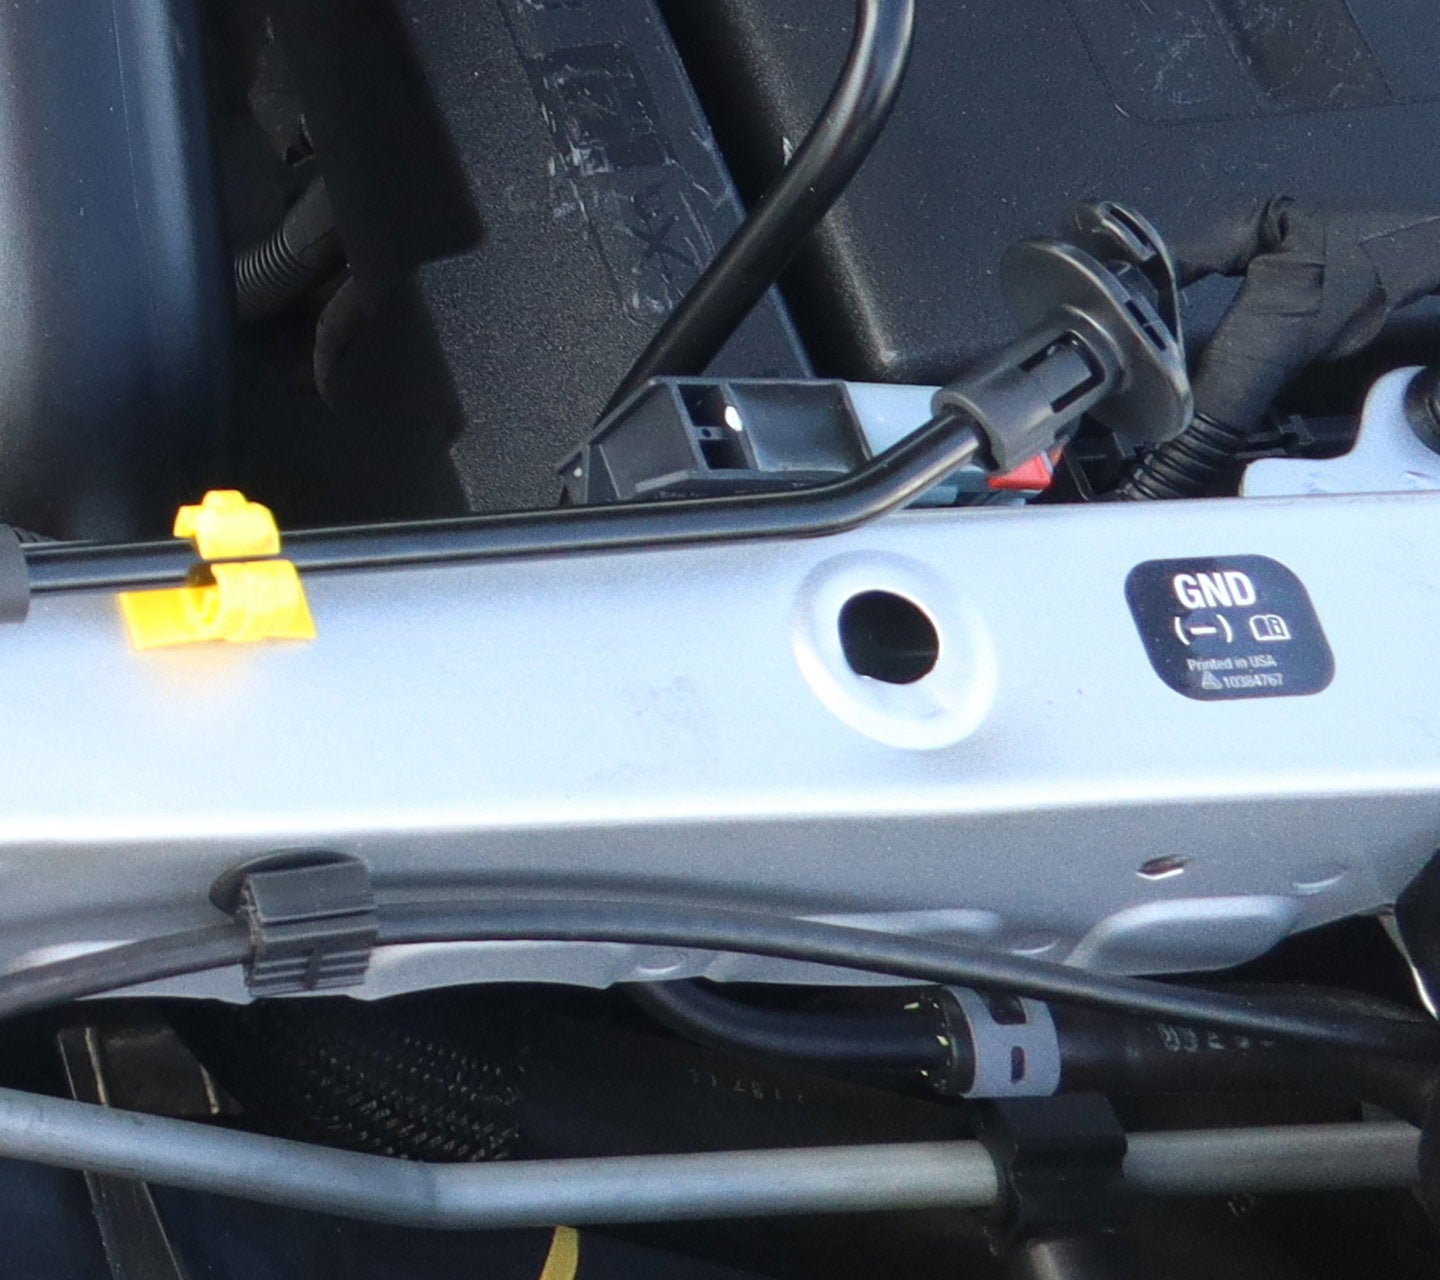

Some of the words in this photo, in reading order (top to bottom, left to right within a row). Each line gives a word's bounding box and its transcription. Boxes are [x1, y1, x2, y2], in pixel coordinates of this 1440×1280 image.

[1172, 571, 1256, 609] GND
[1186, 655, 1234, 671] Printed
[1235, 656, 1248, 669] in
[1249, 654, 1277, 668] USA
